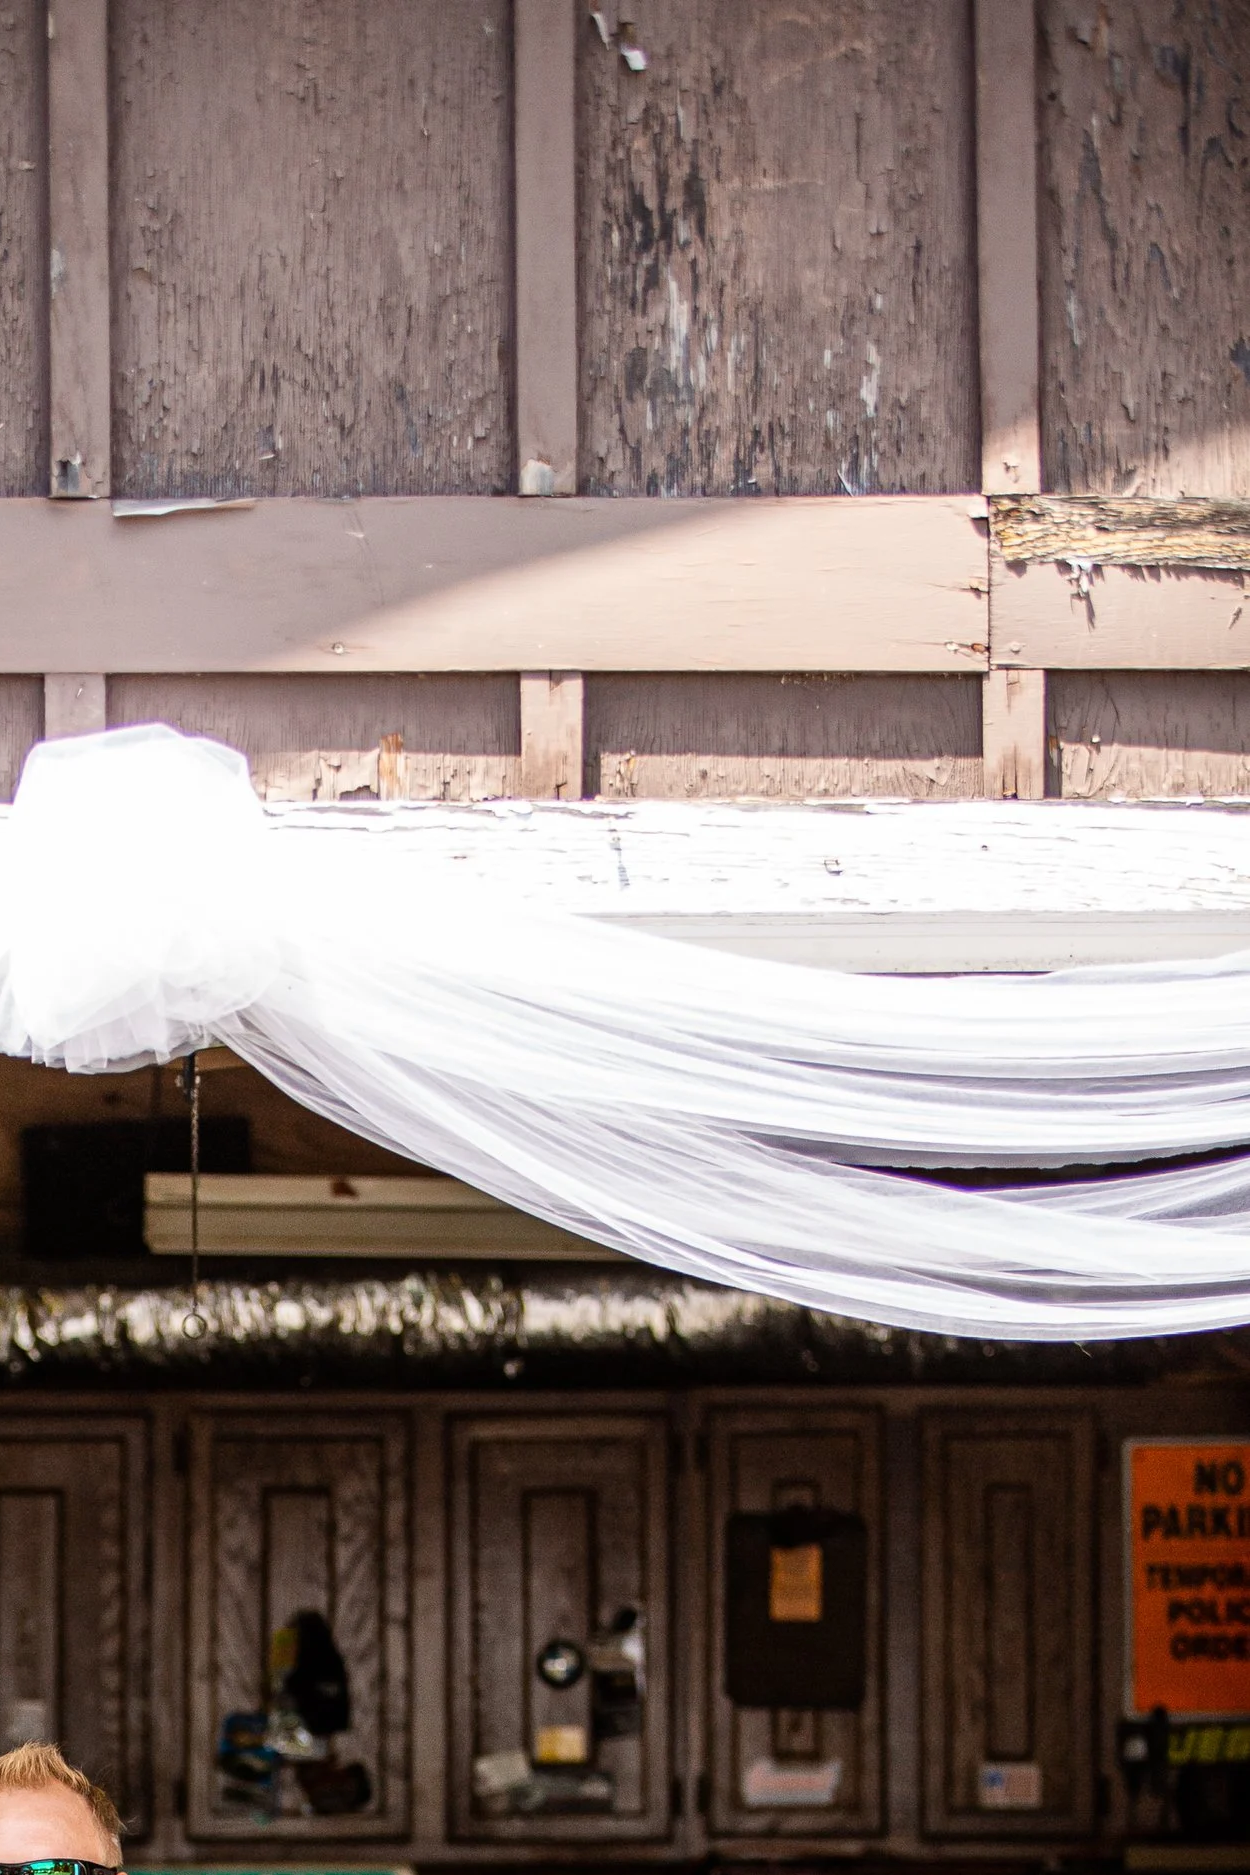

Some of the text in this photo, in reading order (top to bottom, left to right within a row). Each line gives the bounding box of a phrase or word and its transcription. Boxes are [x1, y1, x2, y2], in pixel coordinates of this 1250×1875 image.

[1193, 1460, 1245, 1496] NO
[1141, 1503, 1250, 1541] PARKI
[1146, 1562, 1250, 1591] TEMPOR
